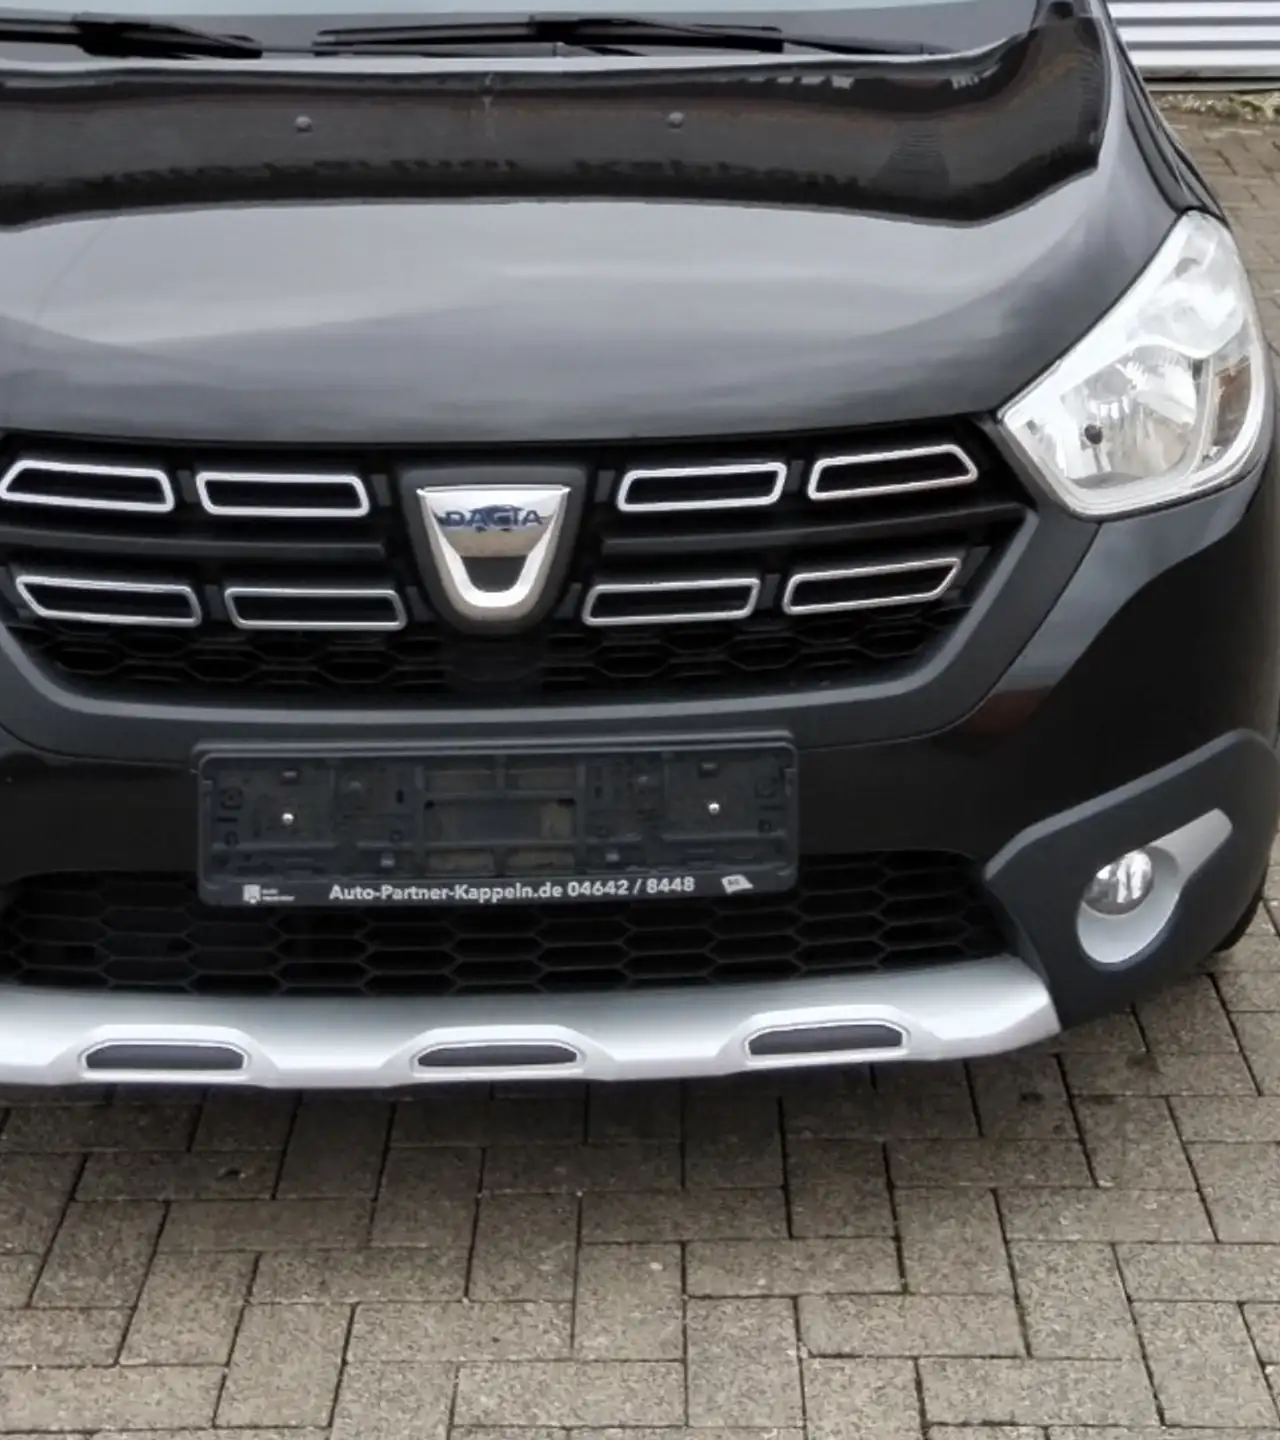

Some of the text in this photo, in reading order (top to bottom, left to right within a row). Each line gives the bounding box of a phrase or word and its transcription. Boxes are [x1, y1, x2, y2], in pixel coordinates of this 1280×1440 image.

[442, 509, 543, 528] DACIA
[329, 876, 695, 903] Auto-Partner-Kappeln.de 04642 / 8448
